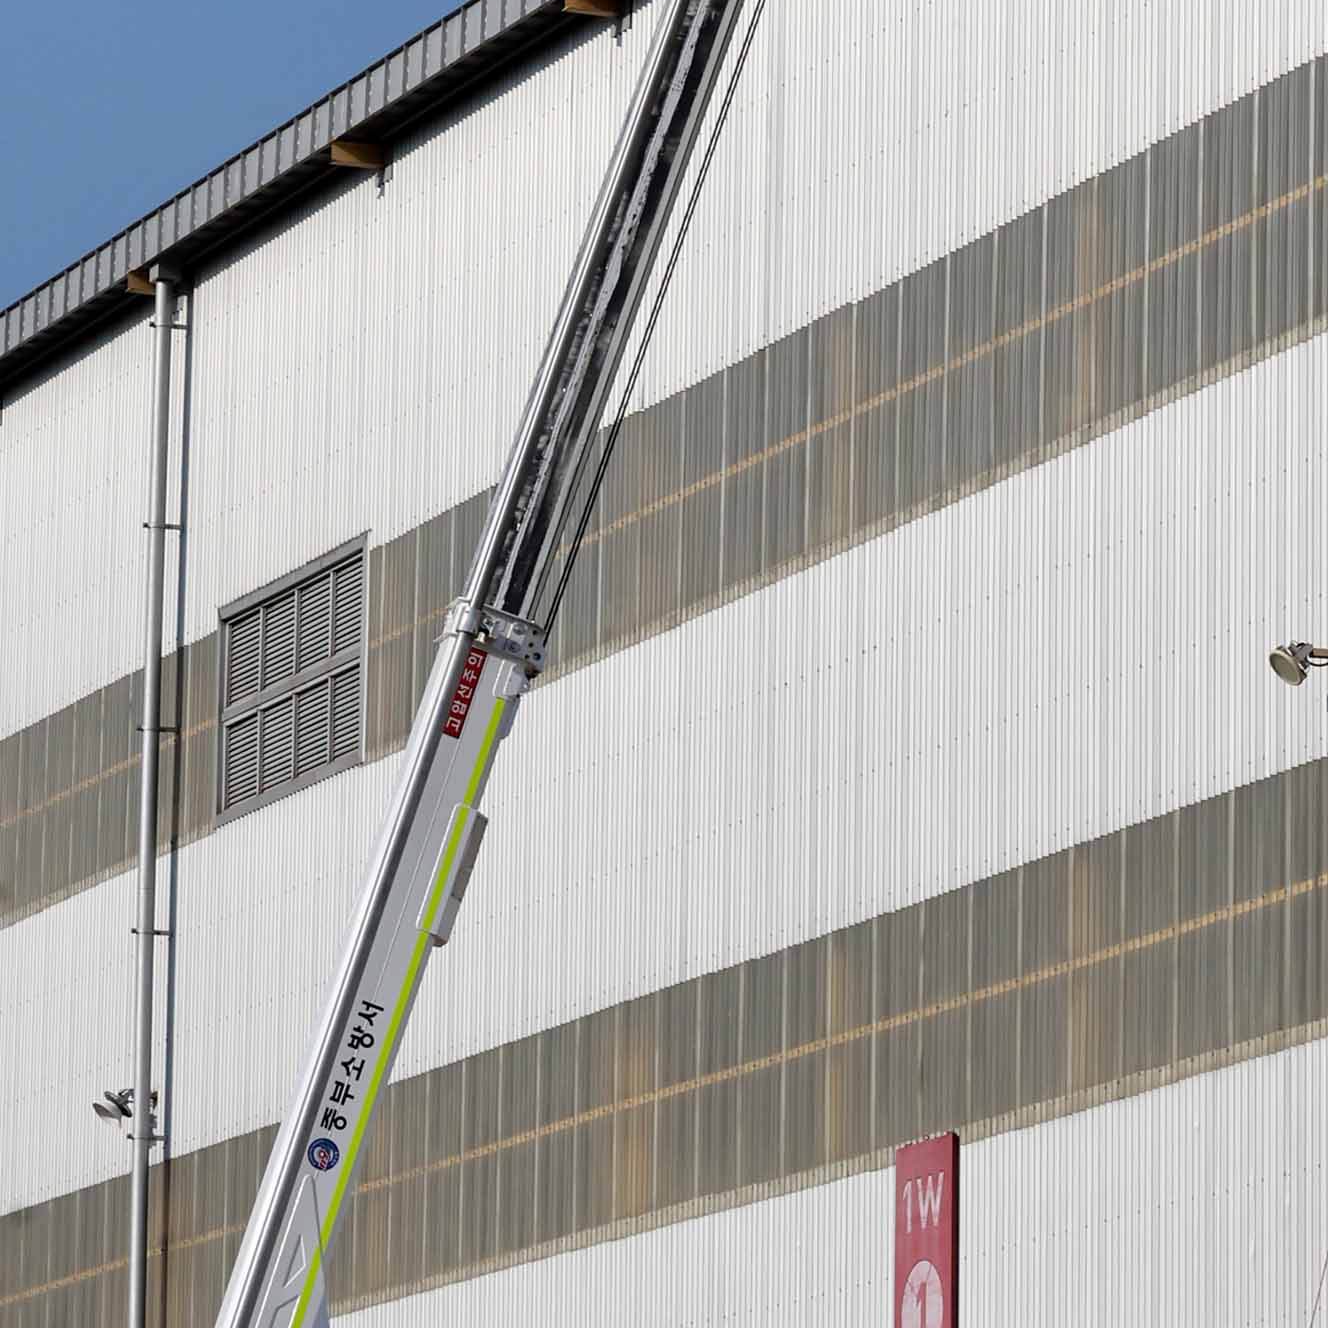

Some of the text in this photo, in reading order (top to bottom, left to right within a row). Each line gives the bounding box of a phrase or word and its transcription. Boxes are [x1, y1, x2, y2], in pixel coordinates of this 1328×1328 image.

[446, 653, 484, 732] 고압선주의
[320, 1000, 385, 1131] 중부소방서
[902, 1171, 945, 1233] 1W
